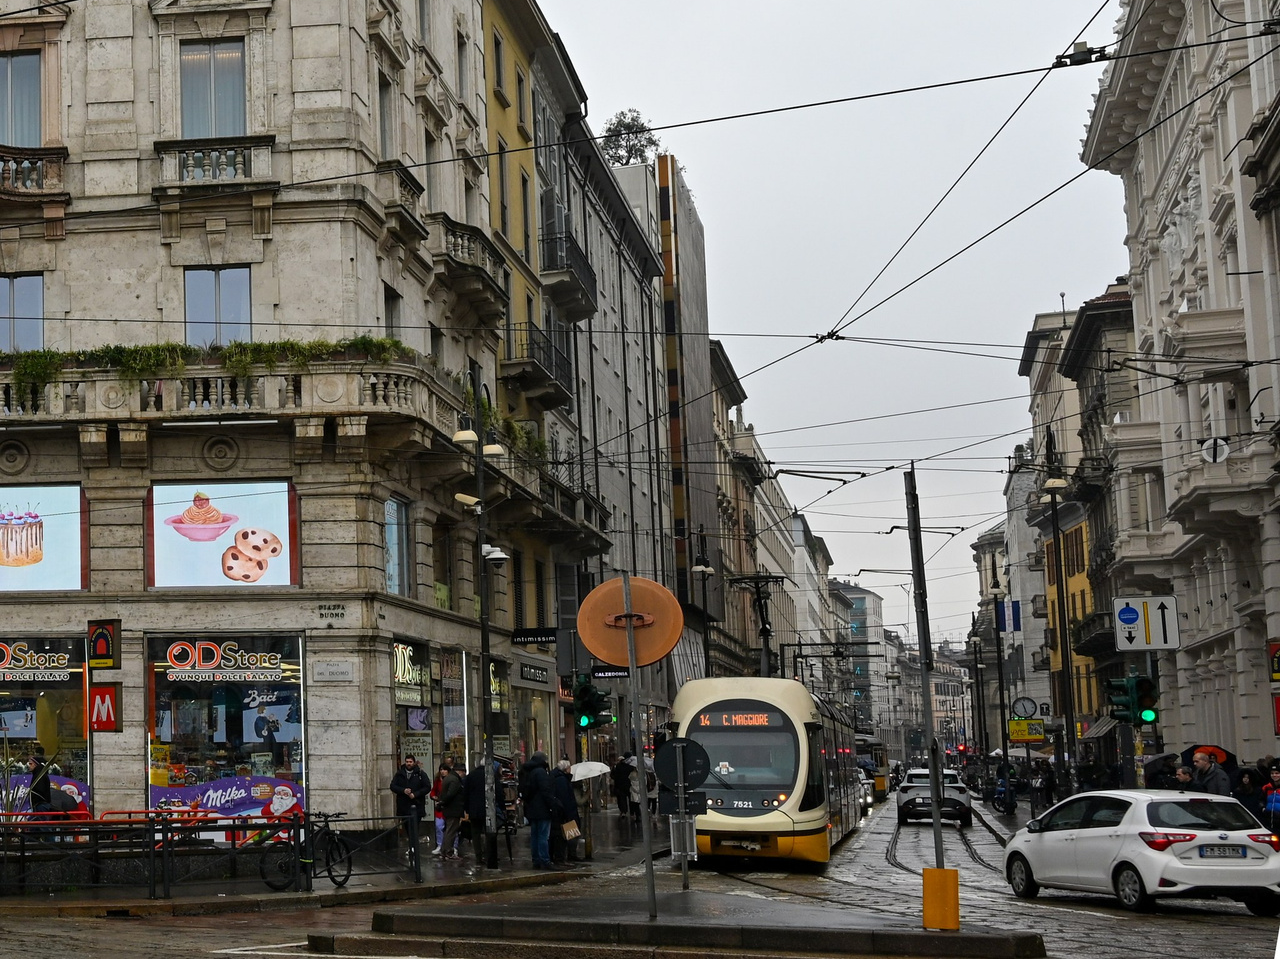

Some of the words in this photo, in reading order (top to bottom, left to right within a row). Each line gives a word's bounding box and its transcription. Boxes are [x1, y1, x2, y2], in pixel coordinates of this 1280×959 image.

[167, 641, 281, 670] ODStore
[5, 673, 33, 682] DOLCE
[34, 673, 70, 682] SALATO
[168, 673, 212, 682] OVUNQUE
[214, 673, 243, 681] DOLCE
[245, 672, 282, 681] SALATO
[92, 694, 115, 722] M
[700, 714, 710, 726] 14
[722, 714, 730, 726] C.
[732, 713, 769, 726] MAGGIORE
[203, 786, 248, 808] Milka
[733, 800, 753, 808] 7521
